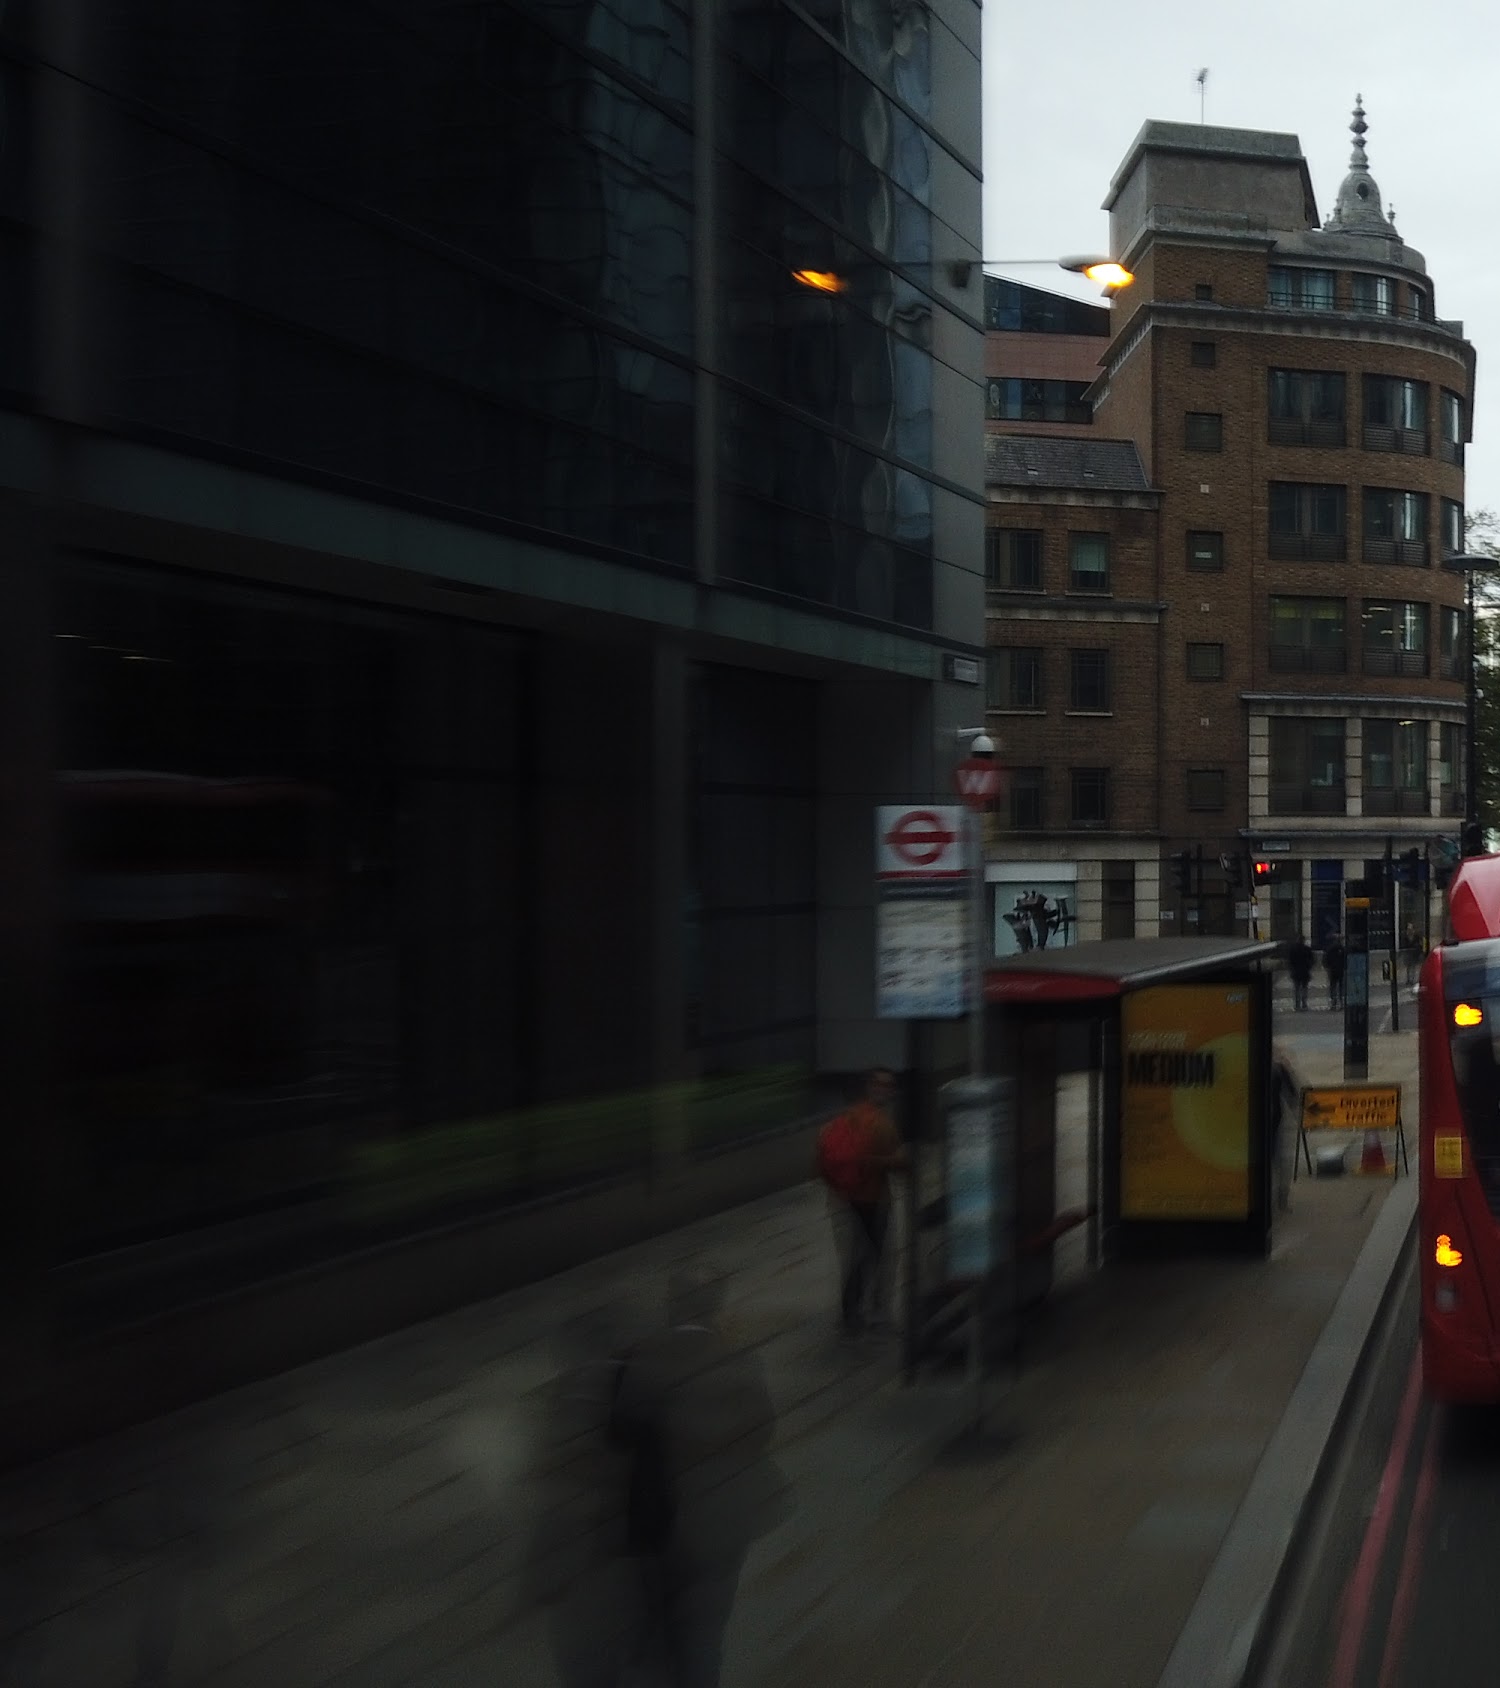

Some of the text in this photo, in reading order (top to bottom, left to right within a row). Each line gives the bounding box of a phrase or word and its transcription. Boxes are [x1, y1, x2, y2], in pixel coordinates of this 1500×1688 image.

[1128, 1052, 1214, 1087] MEDIUM
[1340, 1095, 1395, 1108] Diverted
[1345, 1110, 1387, 1121] traffic
